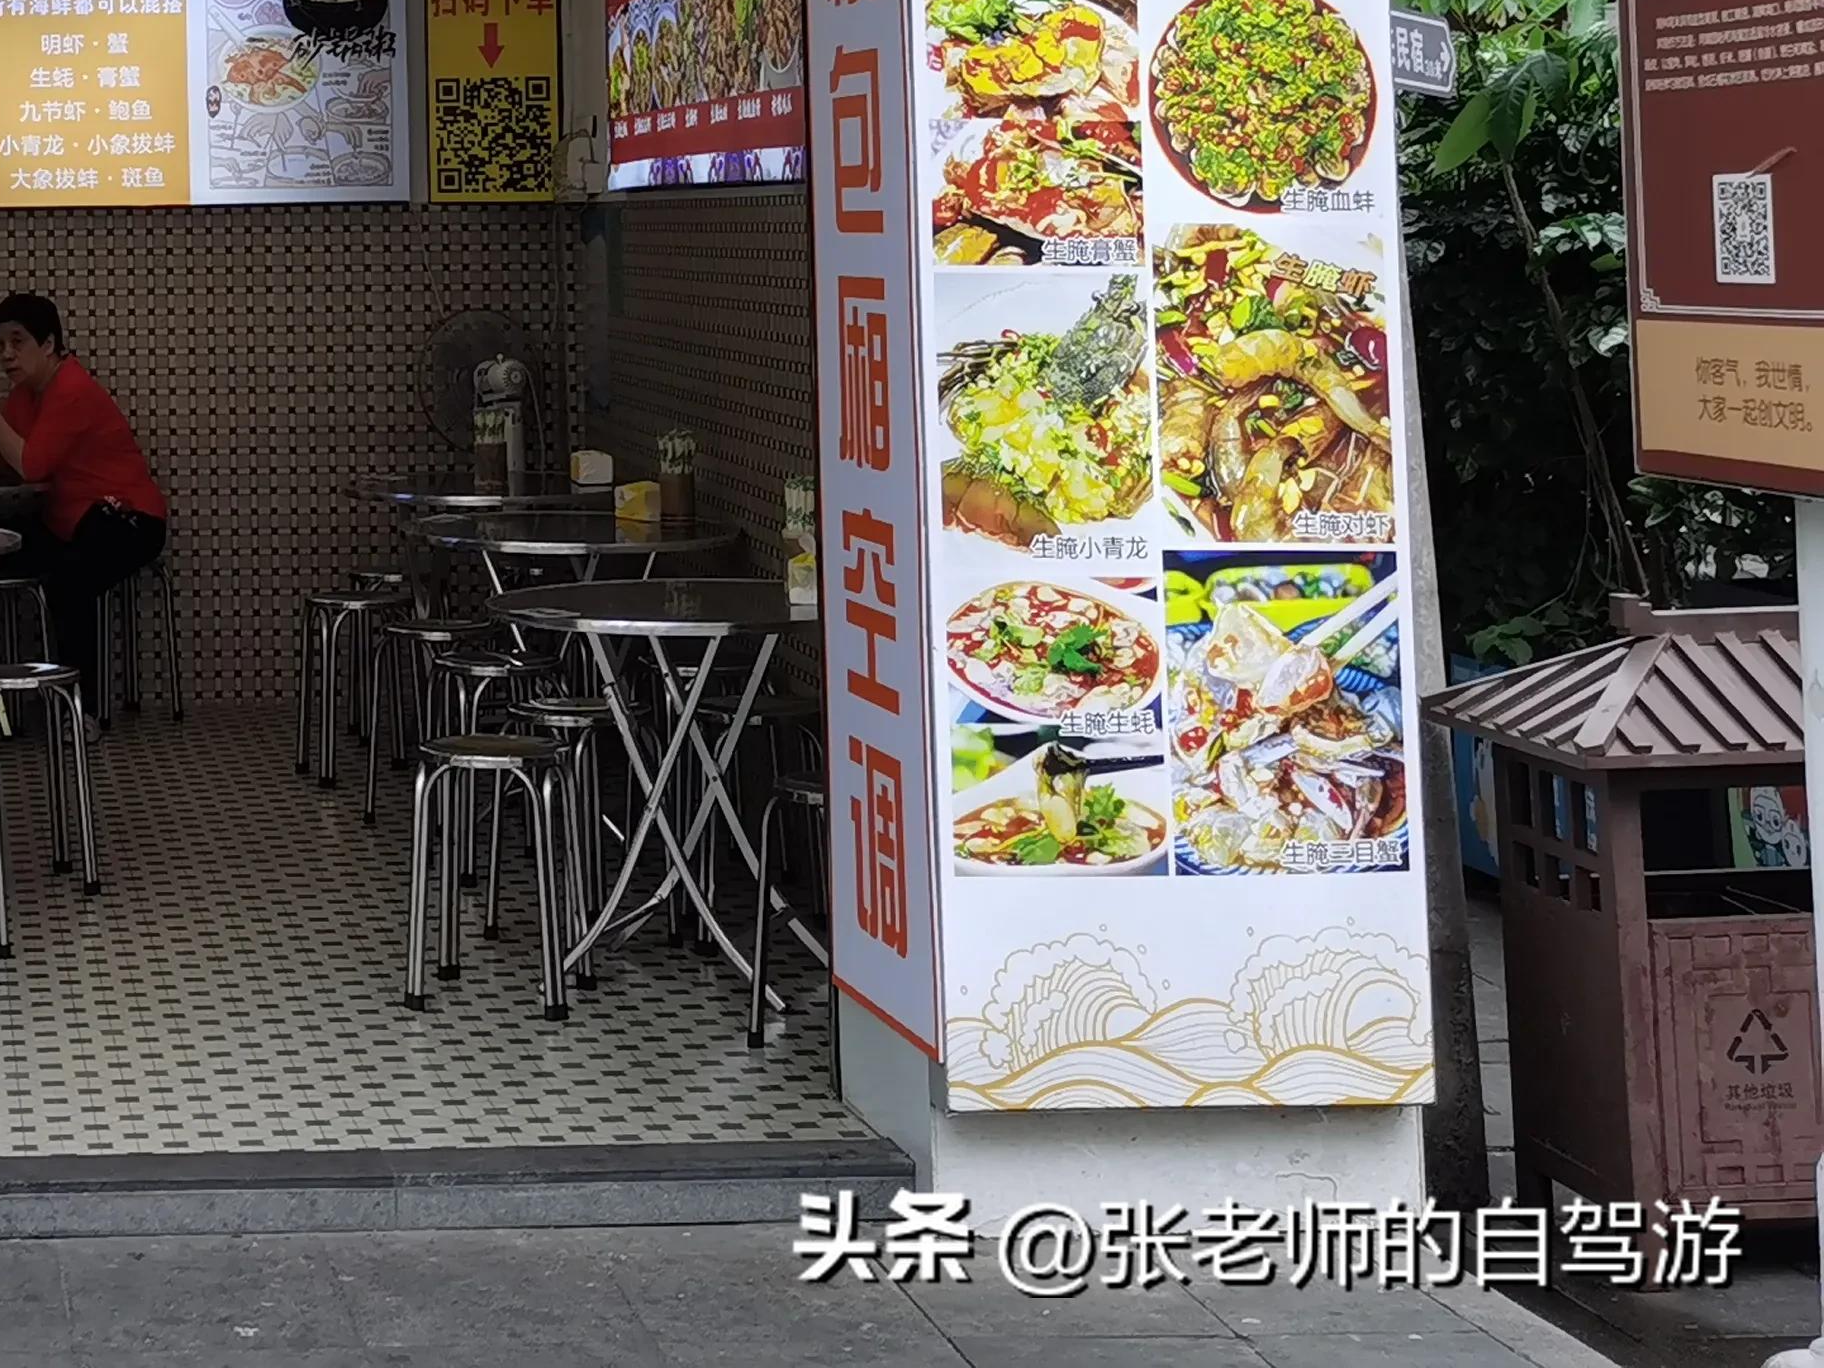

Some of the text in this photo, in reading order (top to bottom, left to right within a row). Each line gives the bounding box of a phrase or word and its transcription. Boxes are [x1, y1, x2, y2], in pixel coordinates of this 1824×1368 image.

[1390, 27, 1424, 73] 民宿
[1284, 189, 1376, 214] 生腌血蚌
[1042, 238, 1137, 263] 生腌膏蟹
[1294, 513, 1391, 537] 生腌对虾
[1032, 537, 1149, 560] 生腌小青龙
[1061, 712, 1155, 736] 生腌生蚝
[1282, 841, 1402, 866] 生腌三目蟹
